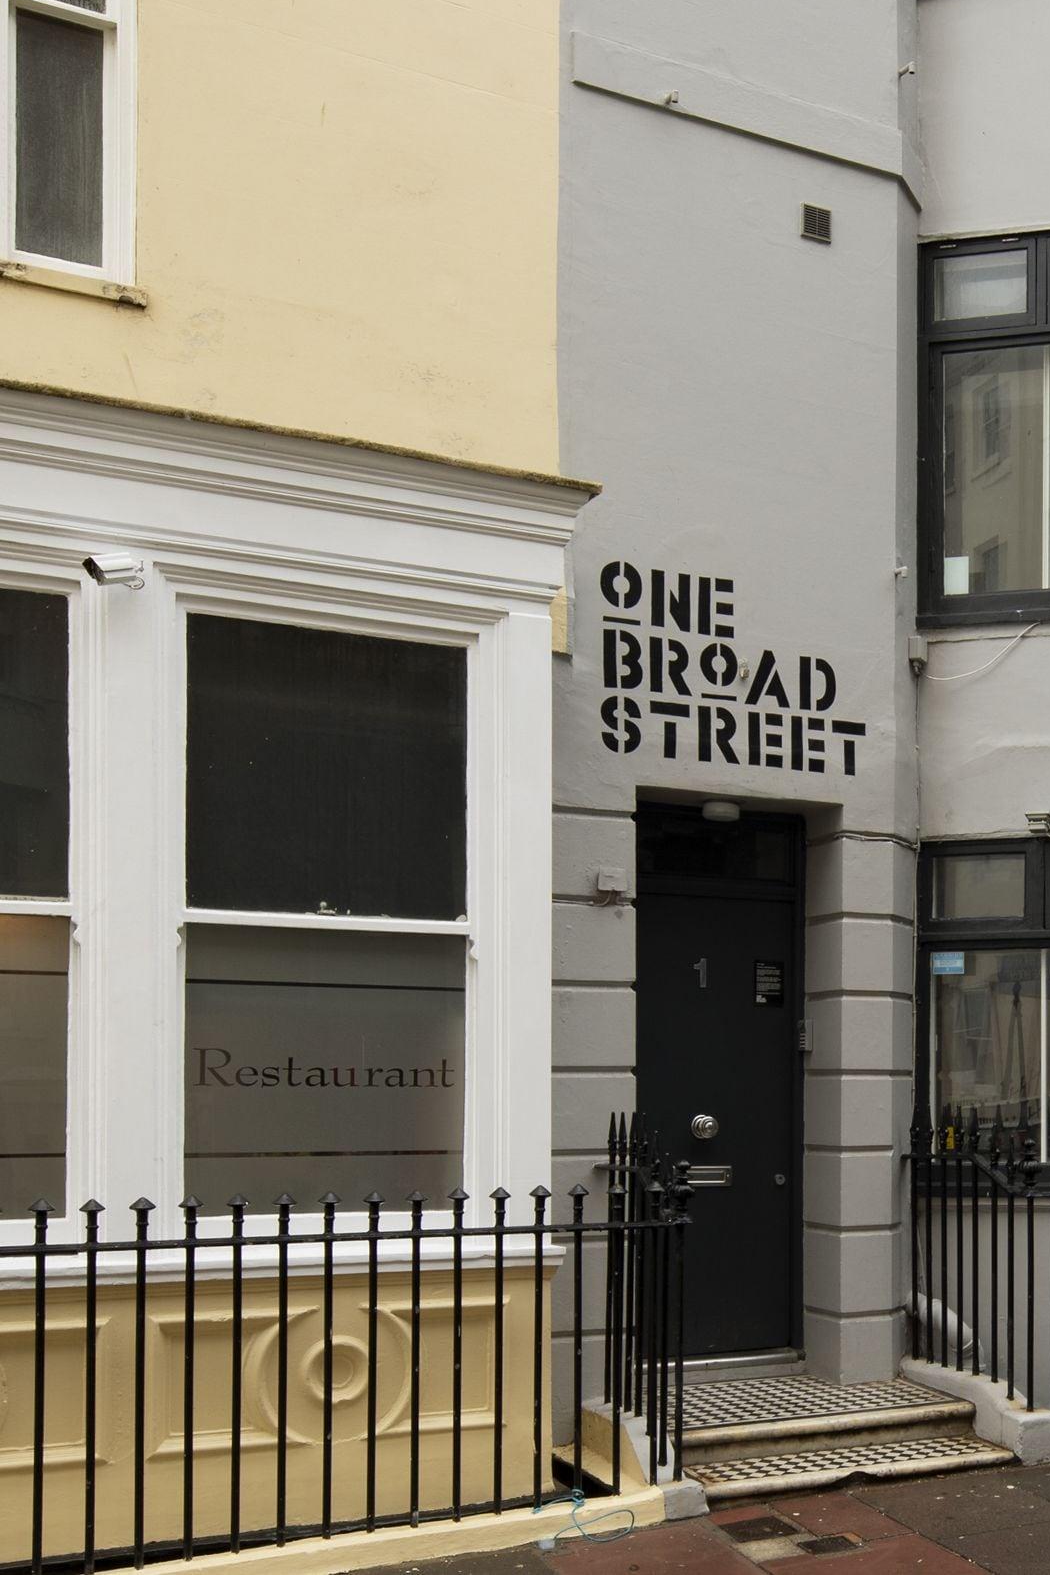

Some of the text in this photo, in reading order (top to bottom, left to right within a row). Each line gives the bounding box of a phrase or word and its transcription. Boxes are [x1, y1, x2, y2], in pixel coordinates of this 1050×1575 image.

[600, 560, 735, 639] ONE
[602, 628, 837, 712] BROAD
[600, 695, 867, 777] STREET
[693, 957, 707, 988] 1
[193, 1047, 456, 1089] Restaurant
